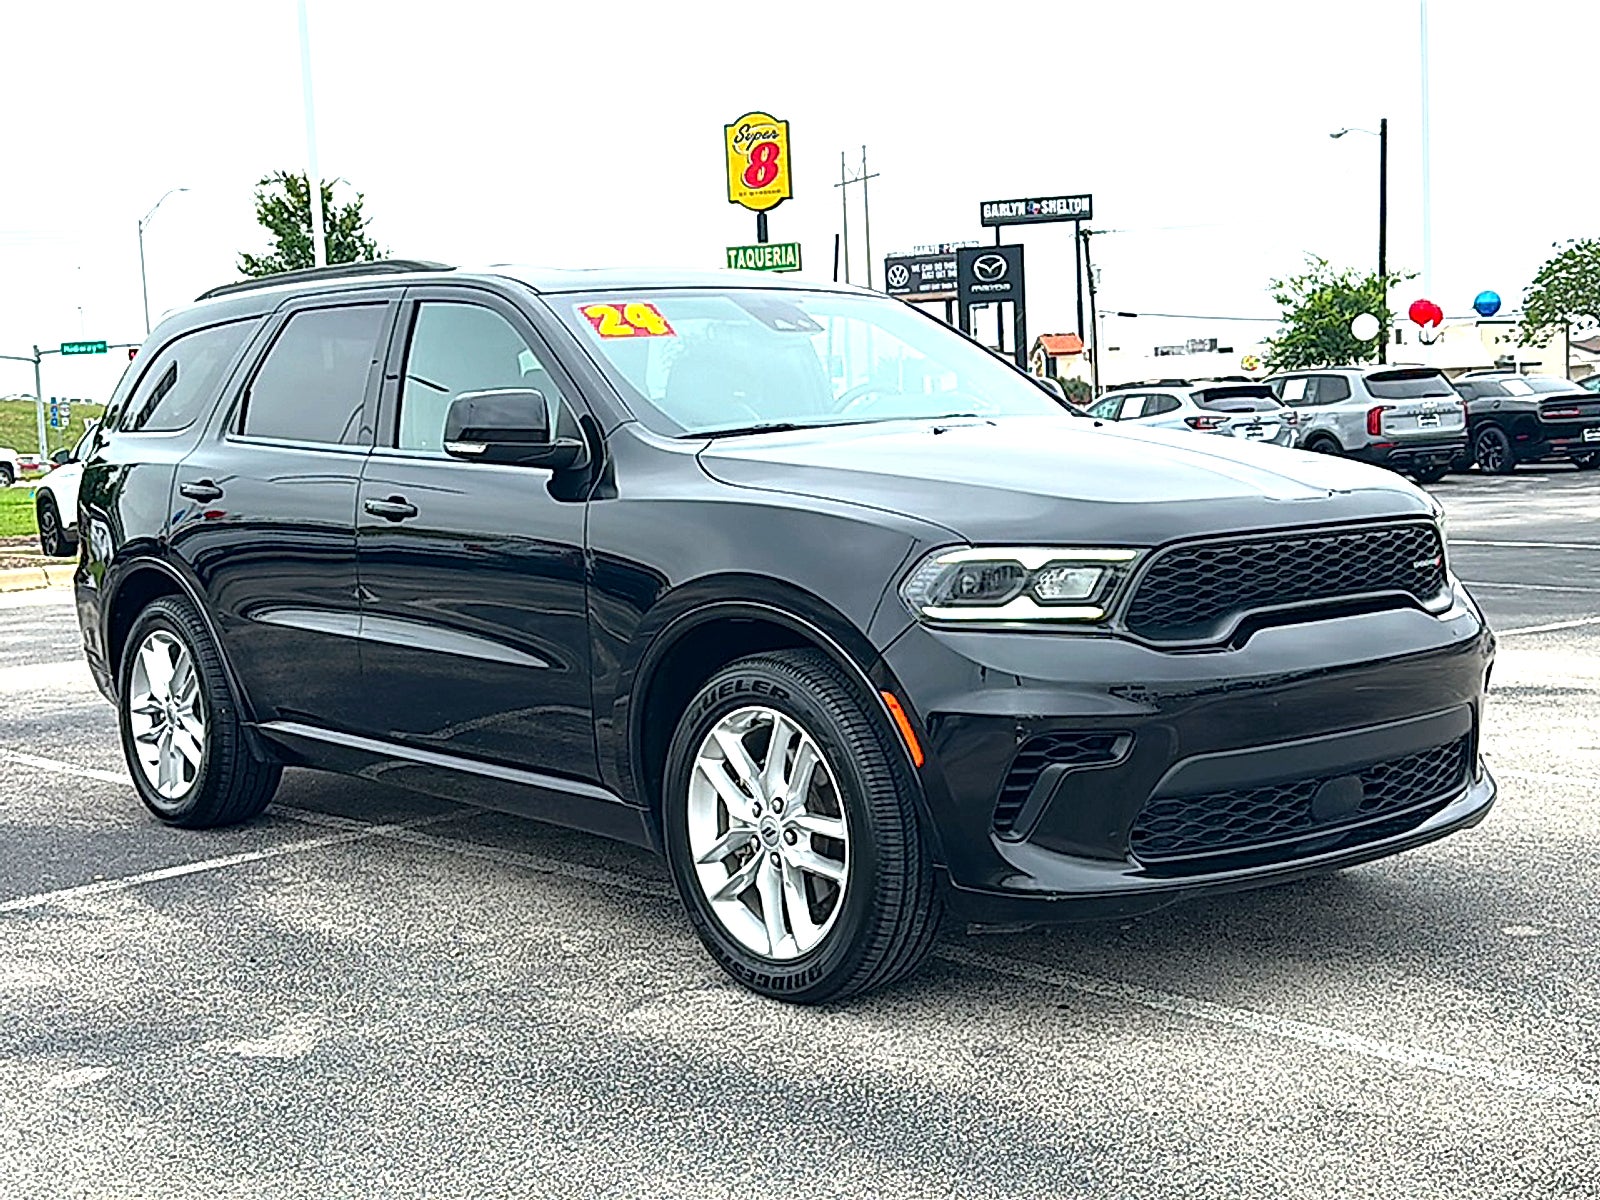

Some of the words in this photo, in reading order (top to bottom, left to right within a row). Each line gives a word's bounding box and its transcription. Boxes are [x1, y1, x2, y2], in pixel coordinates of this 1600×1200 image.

[734, 123, 779, 151] Super
[743, 141, 780, 188] 8
[983, 202, 1026, 218] GARLYN
[1041, 196, 1090, 214] SHELTON
[728, 245, 796, 269] TAQUERIA
[583, 302, 670, 336] 24
